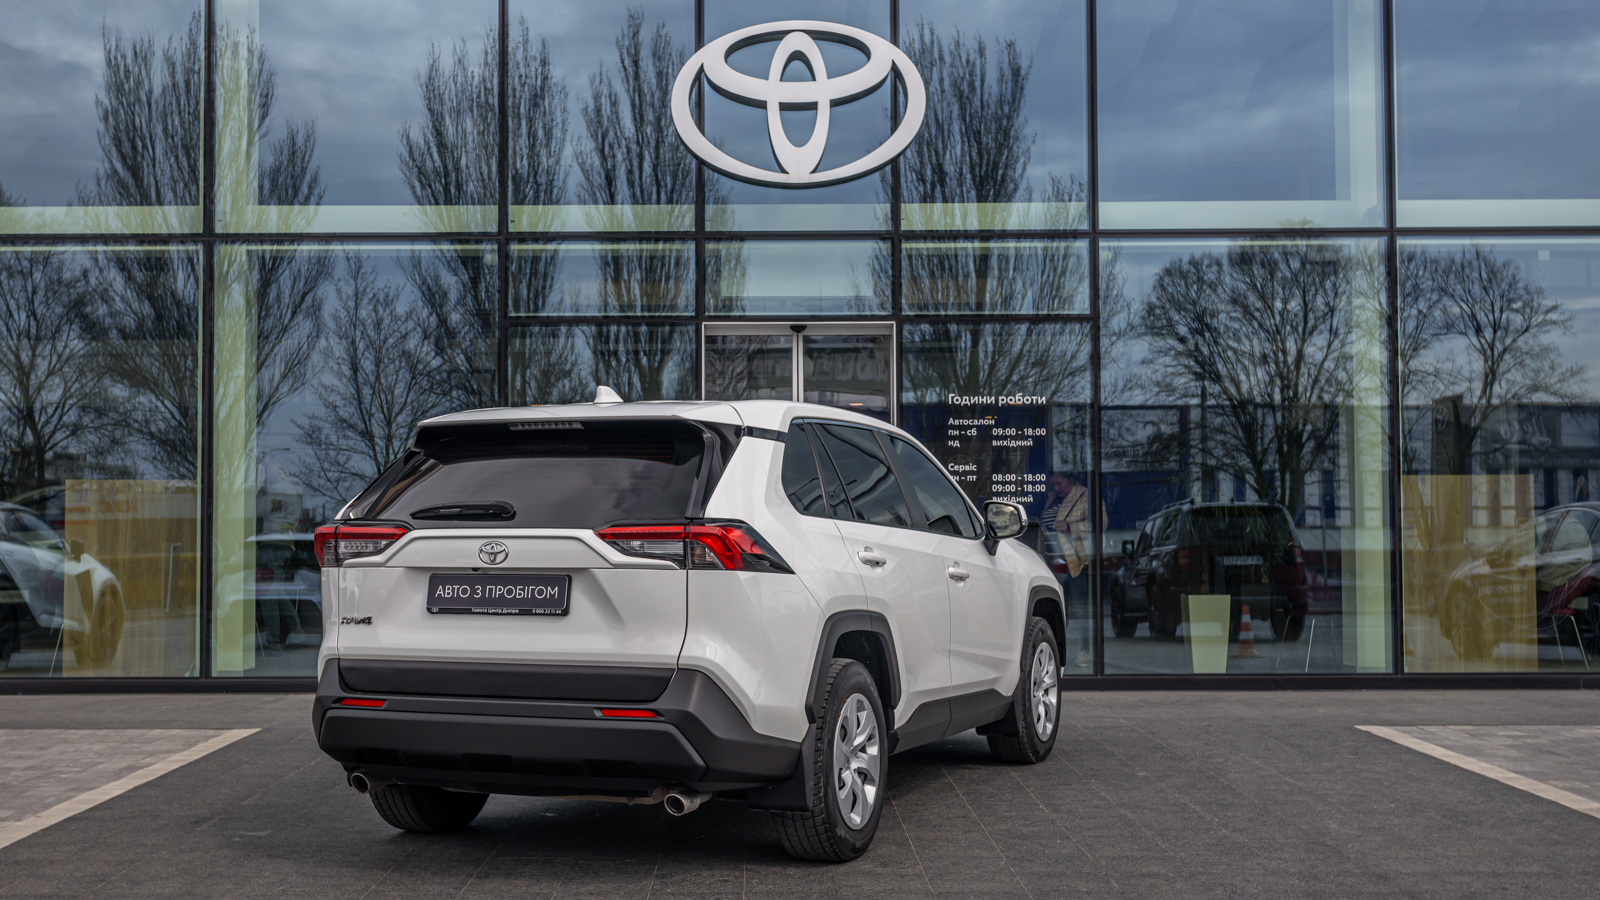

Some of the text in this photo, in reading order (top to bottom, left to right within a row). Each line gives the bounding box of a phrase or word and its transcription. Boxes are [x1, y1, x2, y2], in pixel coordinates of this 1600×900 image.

[948, 393, 1046, 407] Години роботи
[948, 418, 995, 426] Автосалон
[967, 428, 977, 436] сб
[992, 428, 1016, 436] 09:00
[1023, 428, 1046, 436] 18:00
[992, 438, 1033, 447] вихідний
[948, 463, 977, 472] Сервіс
[992, 474, 1016, 482] 08:00
[1023, 474, 1046, 482] 18:00
[992, 484, 1016, 492] 09:00
[1023, 484, 1046, 492] 18:00
[992, 495, 1033, 503] вихідний
[435, 585, 559, 599] АВТО З ПРОБІГОМ
